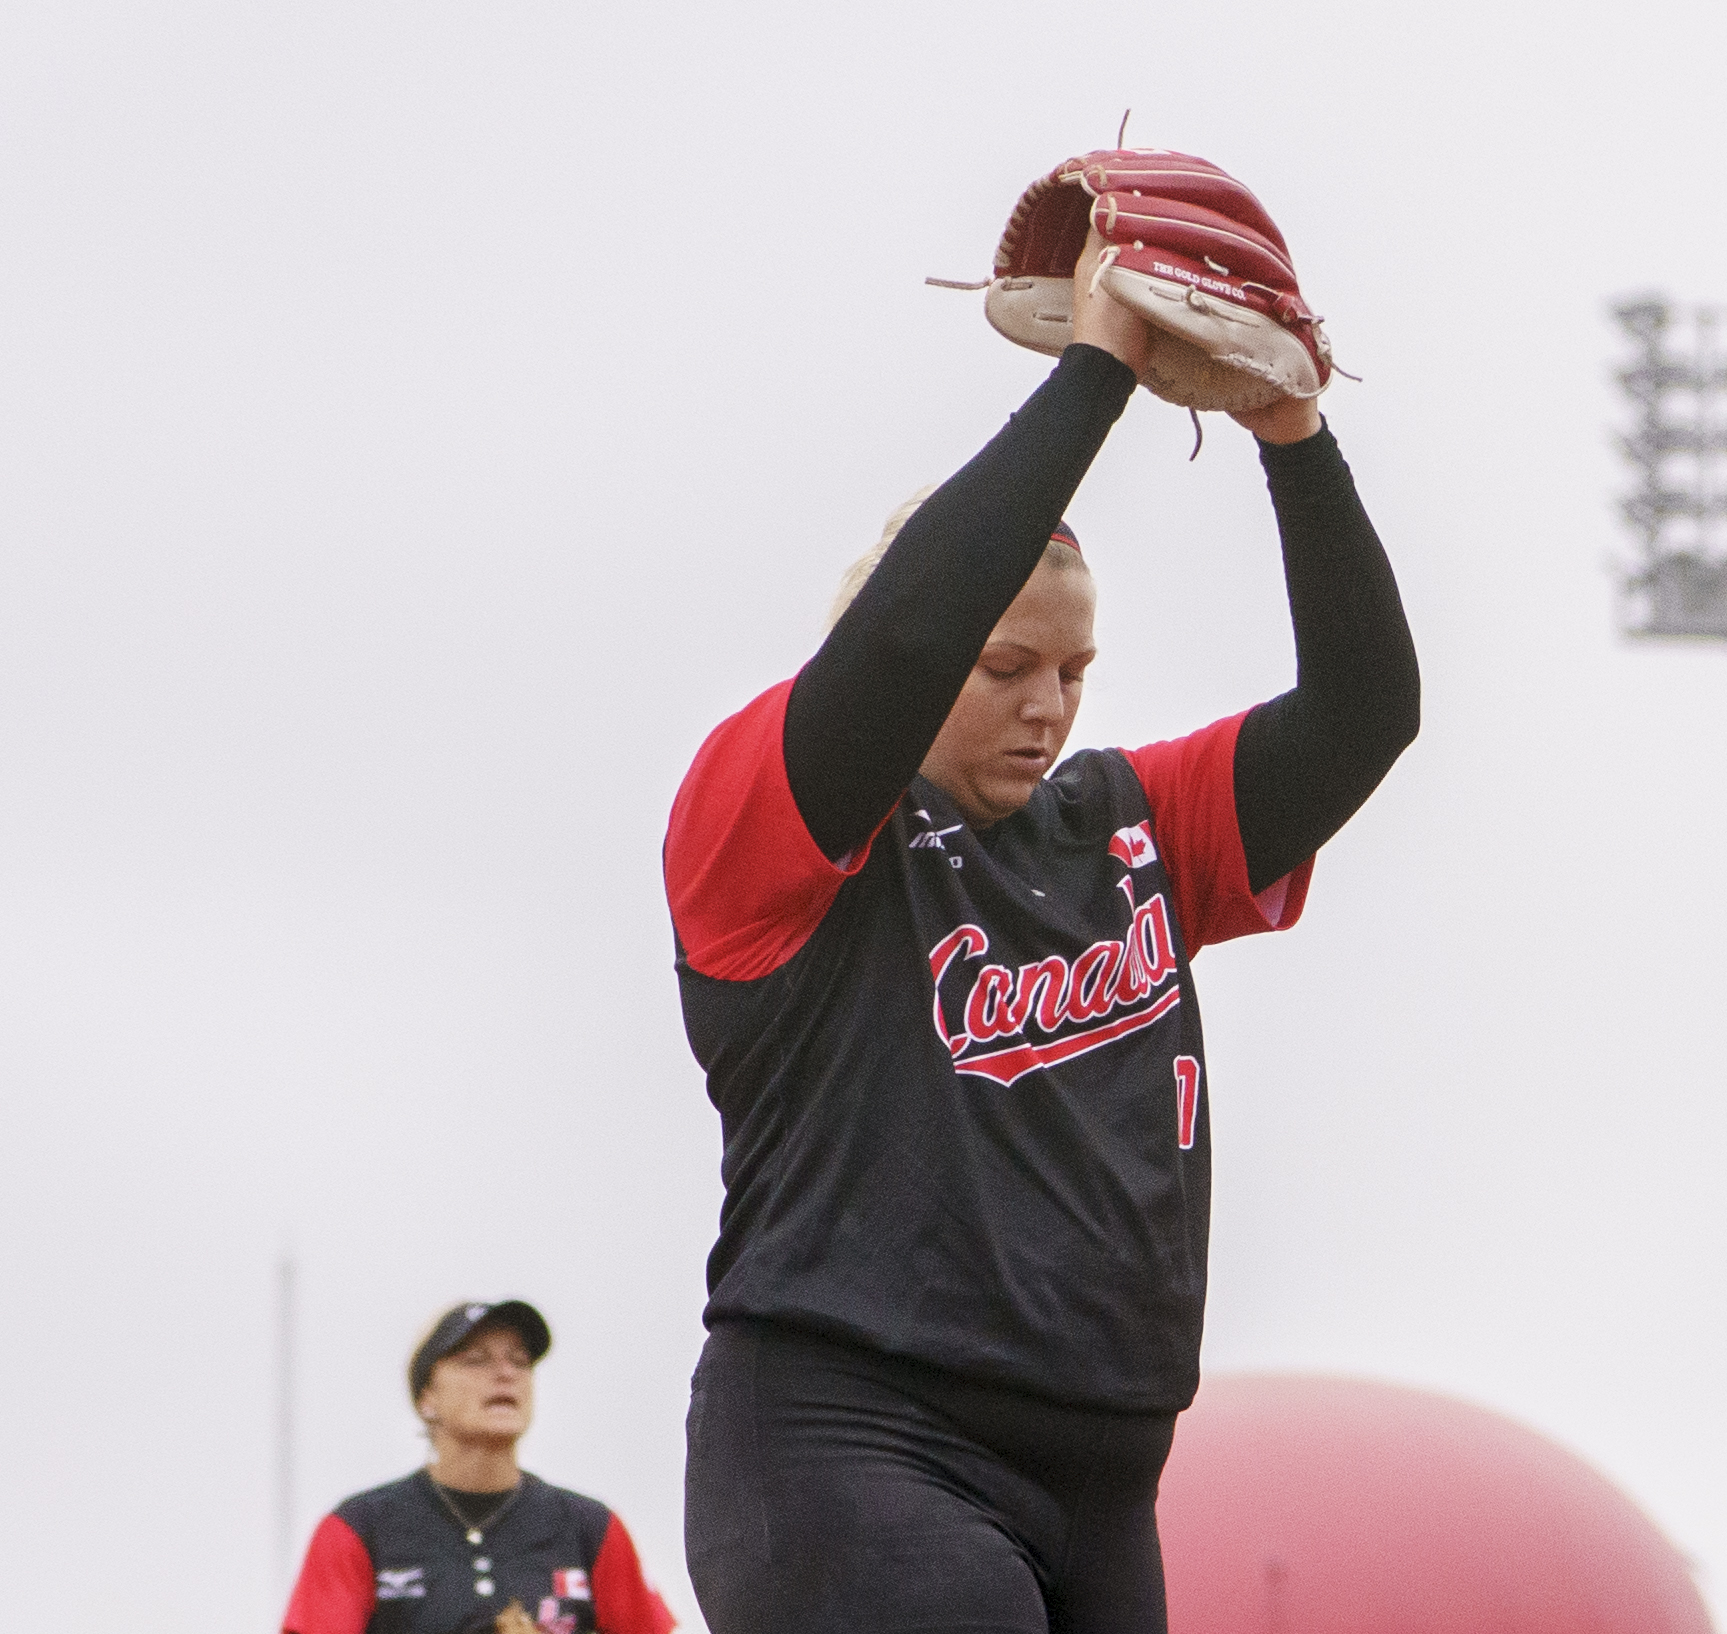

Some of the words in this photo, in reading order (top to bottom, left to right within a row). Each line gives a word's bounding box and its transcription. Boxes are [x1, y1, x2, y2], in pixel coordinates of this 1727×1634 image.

[1153, 261, 1174, 276] THE
[1174, 267, 1200, 284] GOLD
[1201, 276, 1231, 295] GLOVE
